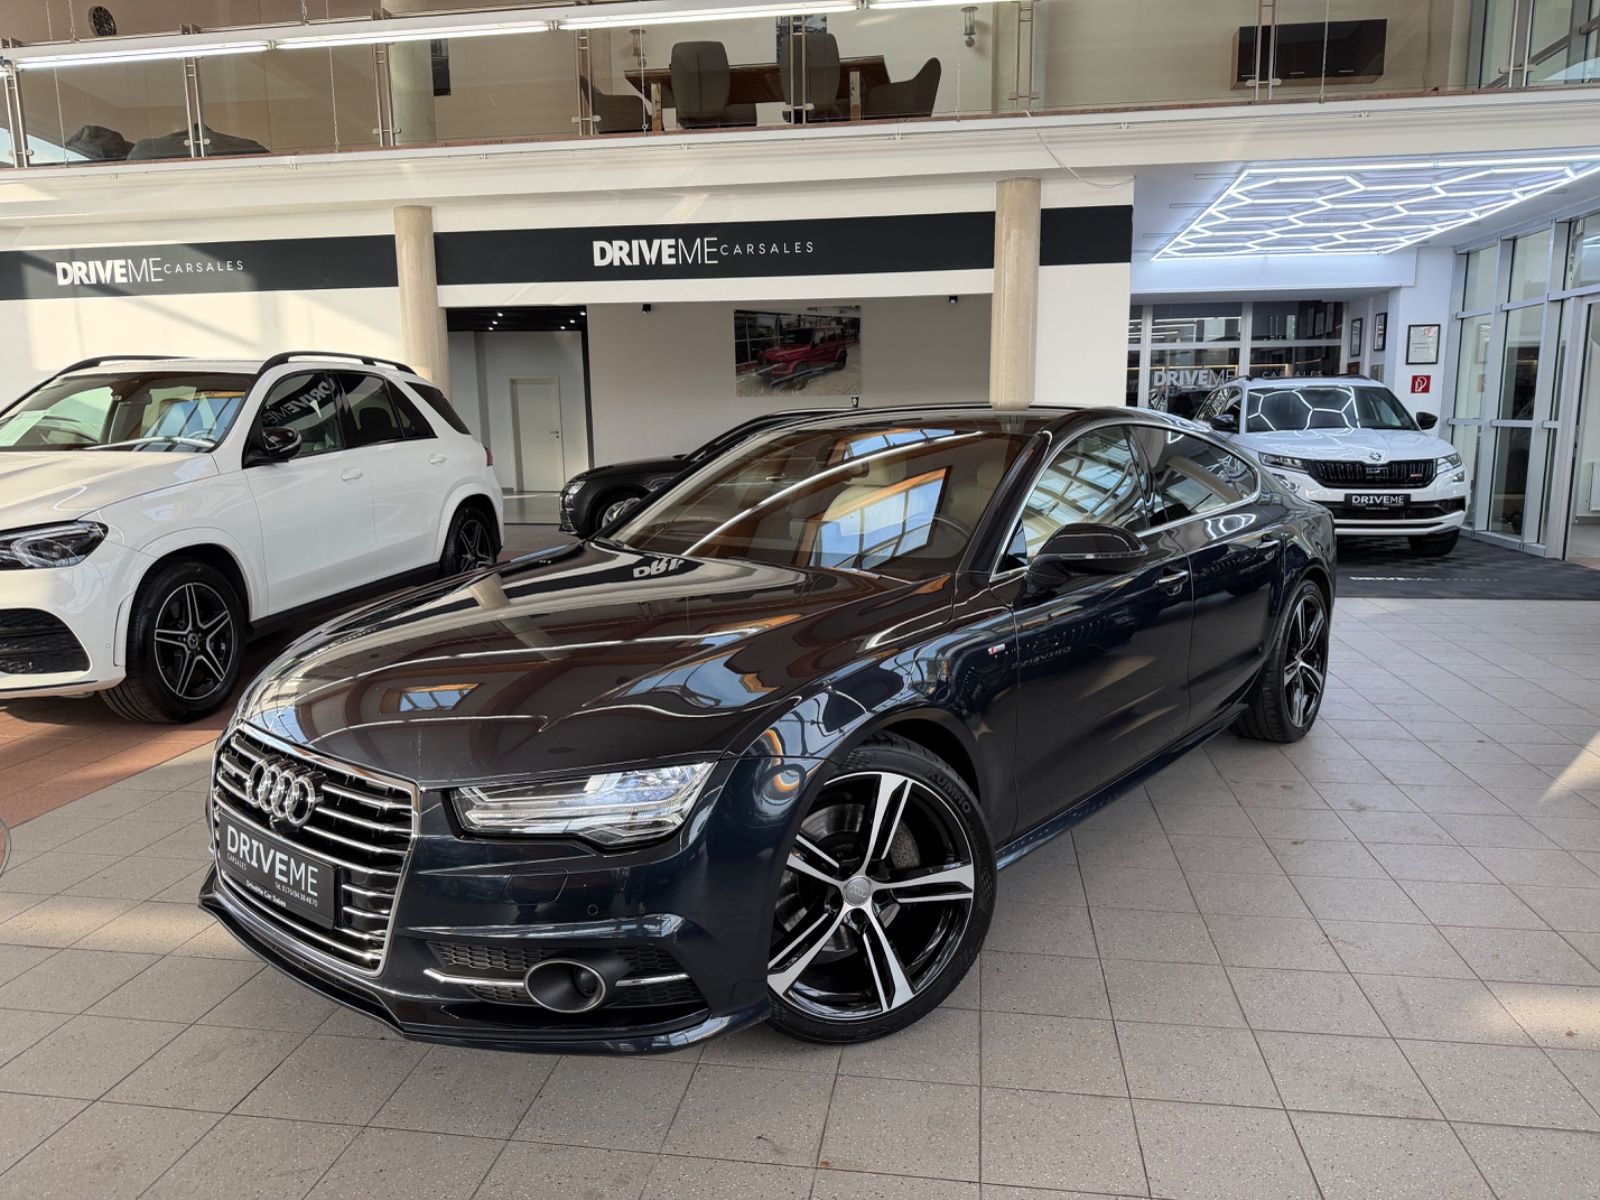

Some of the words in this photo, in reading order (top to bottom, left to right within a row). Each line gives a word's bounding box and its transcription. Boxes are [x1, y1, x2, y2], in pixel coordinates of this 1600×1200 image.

[592, 237, 719, 267] DRIVEME
[720, 241, 814, 255] CARSALES
[55, 257, 164, 286] DRIVEME
[163, 260, 244, 274] CARSALES
[1352, 495, 1404, 504] DRIVEME
[227, 825, 318, 897] DRIVEME
